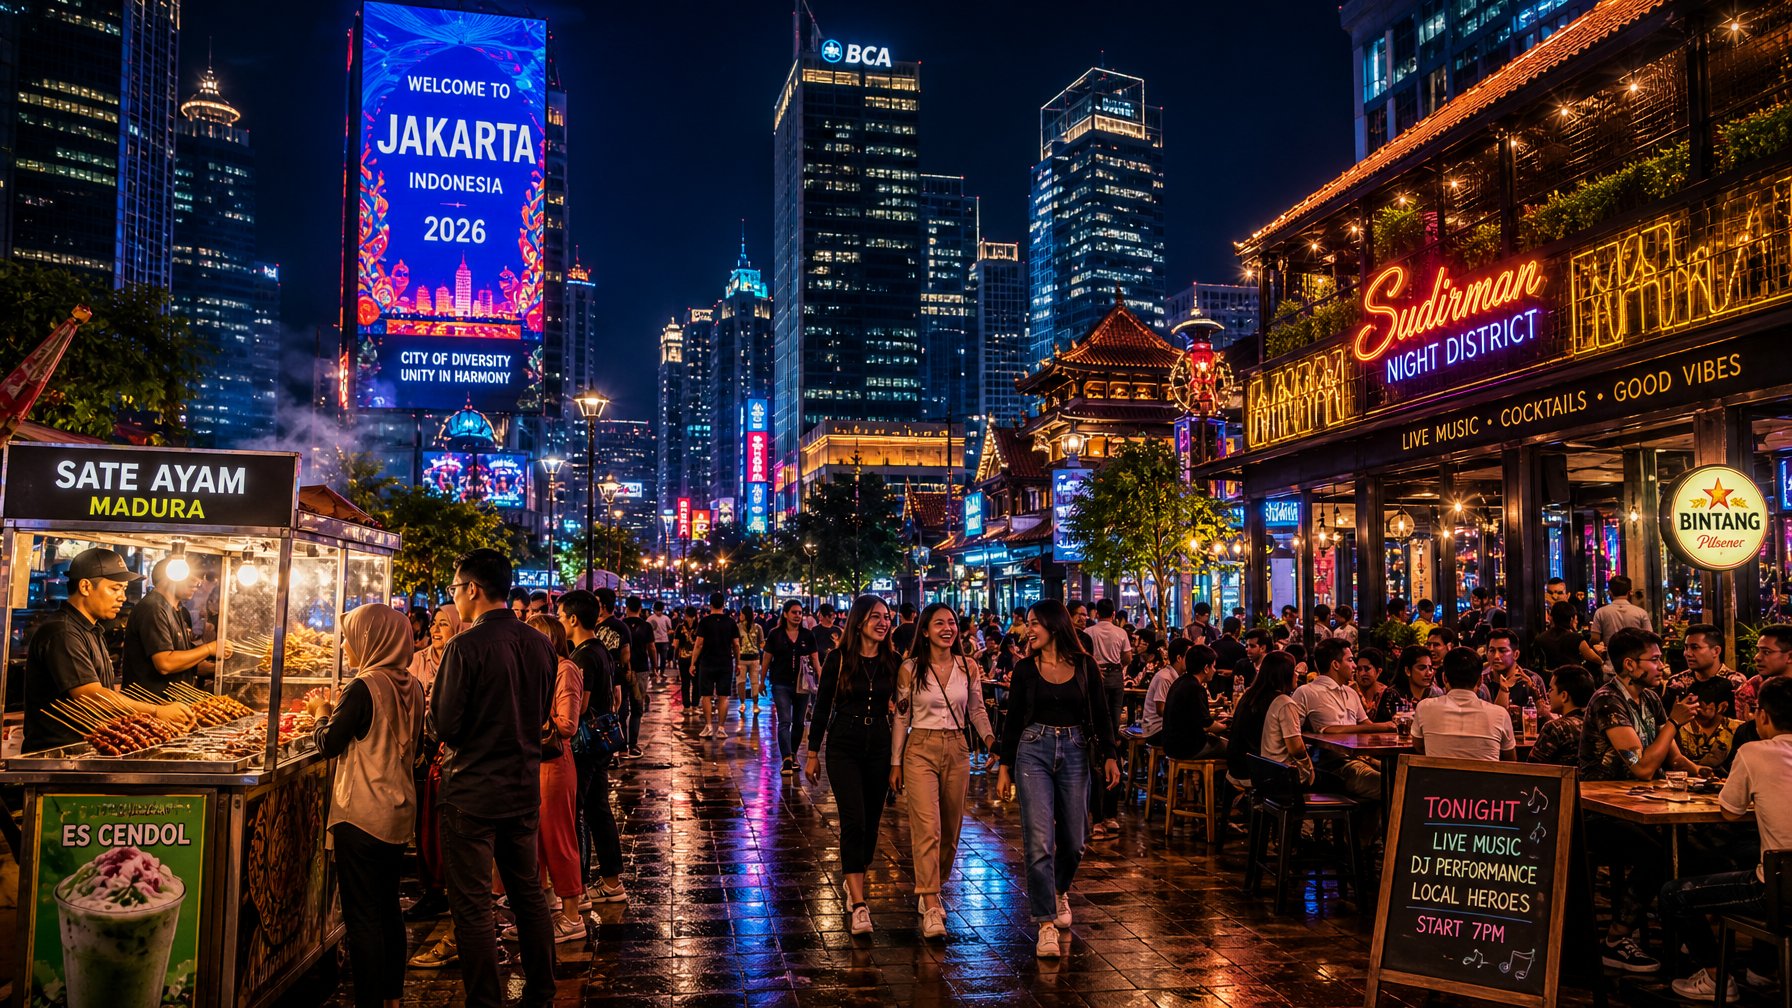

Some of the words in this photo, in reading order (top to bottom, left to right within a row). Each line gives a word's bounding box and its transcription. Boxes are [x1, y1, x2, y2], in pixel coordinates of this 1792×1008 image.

[845, 43, 892, 68] BCA
[407, 75, 486, 97] WELCOME
[490, 82, 510, 99] TO
[377, 113, 536, 165] JAKARTA
[409, 171, 503, 194] INDONESIA
[424, 215, 487, 244] 2026
[1354, 260, 1542, 361] Sudirman
[400, 351, 429, 365] CITY
[432, 352, 448, 365] OF
[452, 353, 511, 367] DIVERSITY
[1386, 342, 1439, 384] NIGHT
[1446, 308, 1538, 366] DISTRICT
[400, 368, 435, 382] UNITY
[439, 369, 451, 382] IN
[454, 370, 511, 384] HARMONY
[1402, 428, 1429, 450] LIVE
[1436, 416, 1479, 443] MUSIC
[1500, 390, 1587, 428] COCKTAILS
[1613, 370, 1672, 402] GOOD
[1682, 353, 1742, 386] VIBES
[55, 460, 138, 491] SATE
[150, 464, 246, 494] AYAM
[89, 496, 206, 519] MADURA
[1679, 512, 1760, 531] BINTANG
[1423, 796, 1521, 822] TONIGHT
[62, 823, 91, 847] ES
[97, 823, 191, 846] CENDOL
[1433, 832, 1467, 852] LIVE
[1473, 834, 1521, 856] MUSIC
[1410, 855, 1432, 875] DJ
[1435, 857, 1538, 885] PERFORMANCE
[1411, 882, 1460, 904] LOCAL
[1467, 888, 1530, 913] HEROES
[1416, 915, 1464, 938] START
[1472, 922, 1505, 943] 7PM
